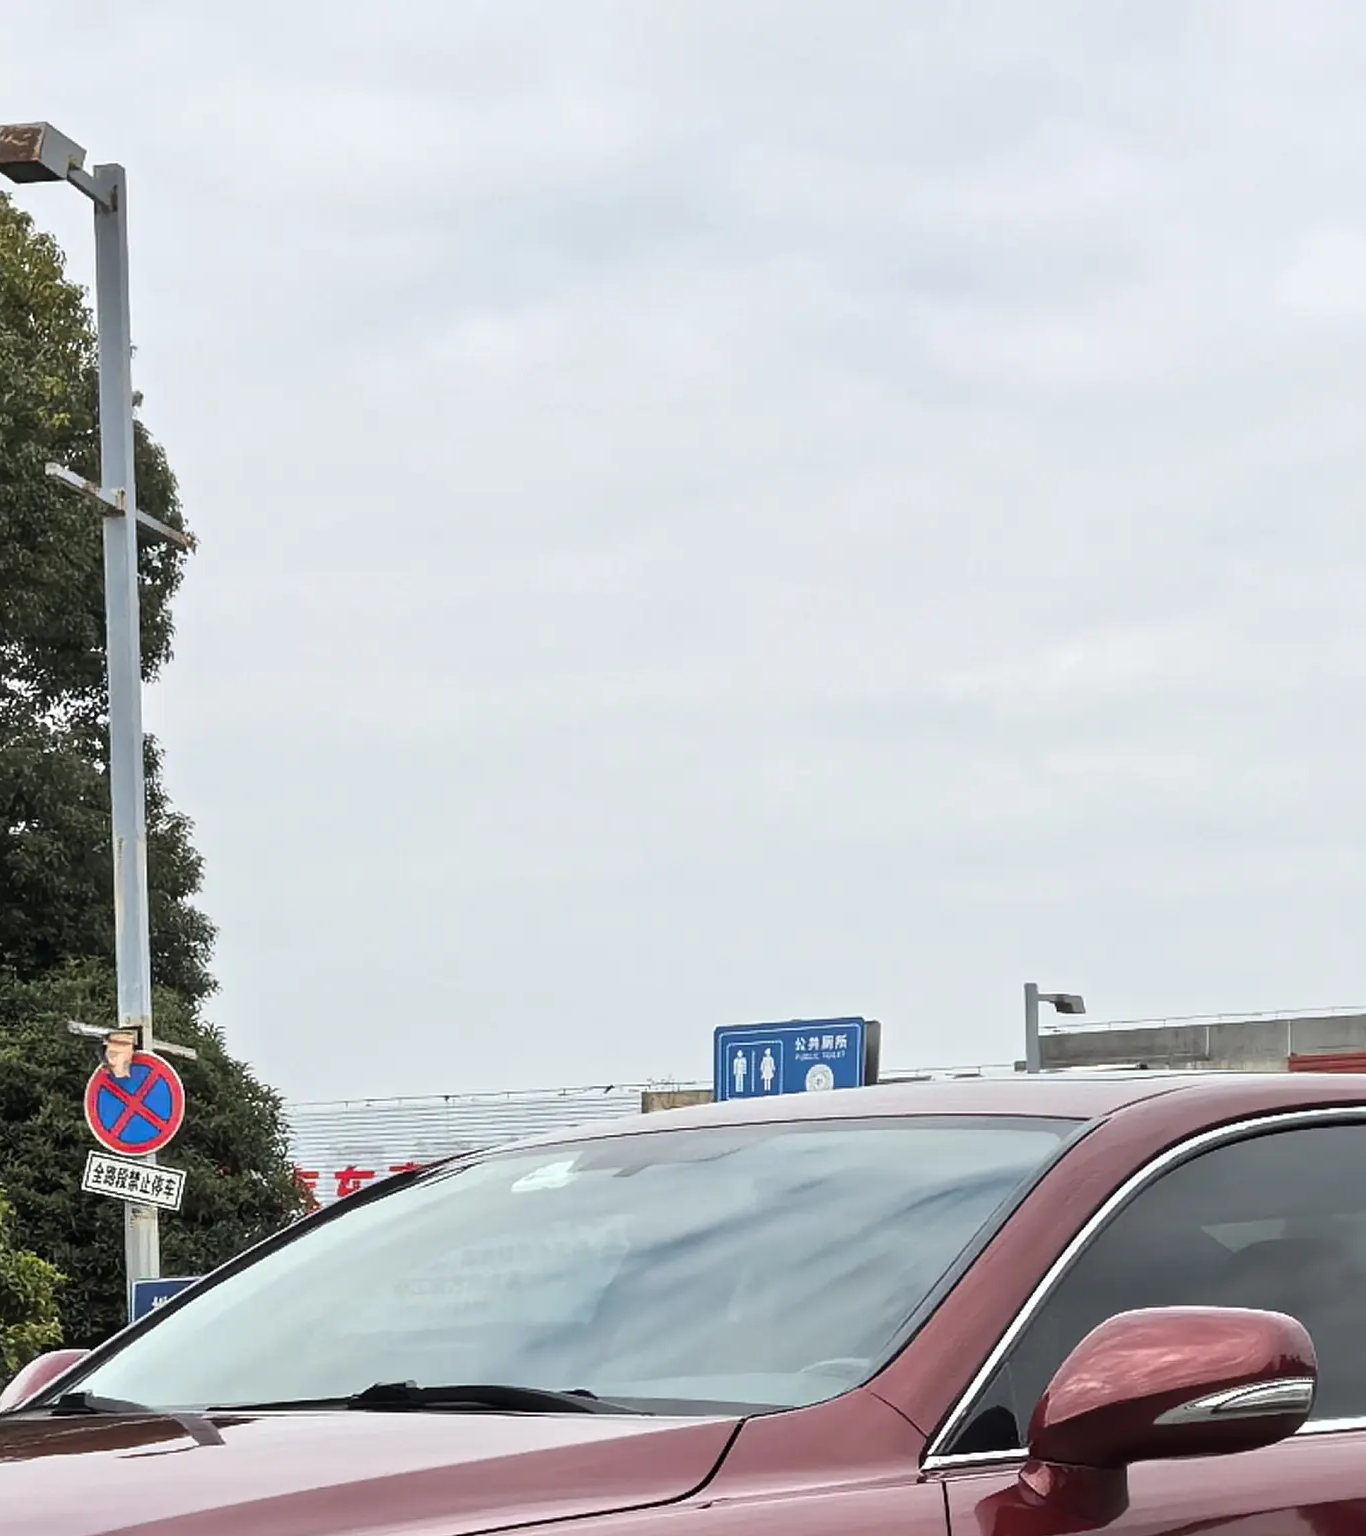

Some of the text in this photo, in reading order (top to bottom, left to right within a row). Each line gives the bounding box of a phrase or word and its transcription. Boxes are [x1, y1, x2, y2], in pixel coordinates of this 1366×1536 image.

[795, 1033, 847, 1051] 公共厕所
[91, 1162, 176, 1199] 全路段禁止停车
